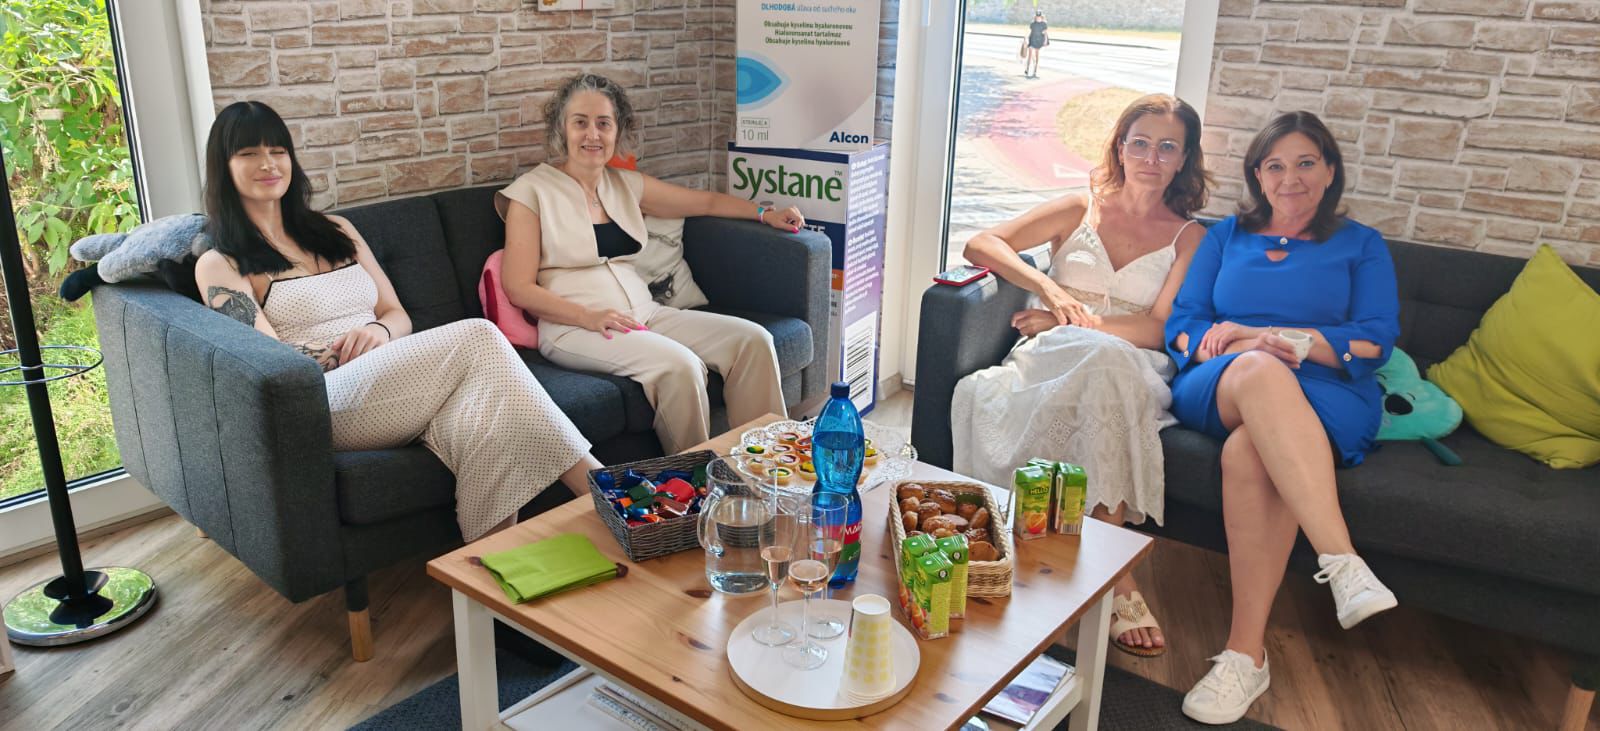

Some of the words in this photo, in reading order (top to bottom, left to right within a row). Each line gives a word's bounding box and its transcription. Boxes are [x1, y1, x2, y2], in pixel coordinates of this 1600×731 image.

[764, 20, 790, 29] Obsahuje
[765, 37, 791, 45] Obsahuje
[742, 129, 754, 141] 10
[758, 130, 768, 141] ml
[829, 132, 869, 144] Alcon
[732, 157, 842, 202] Systane
